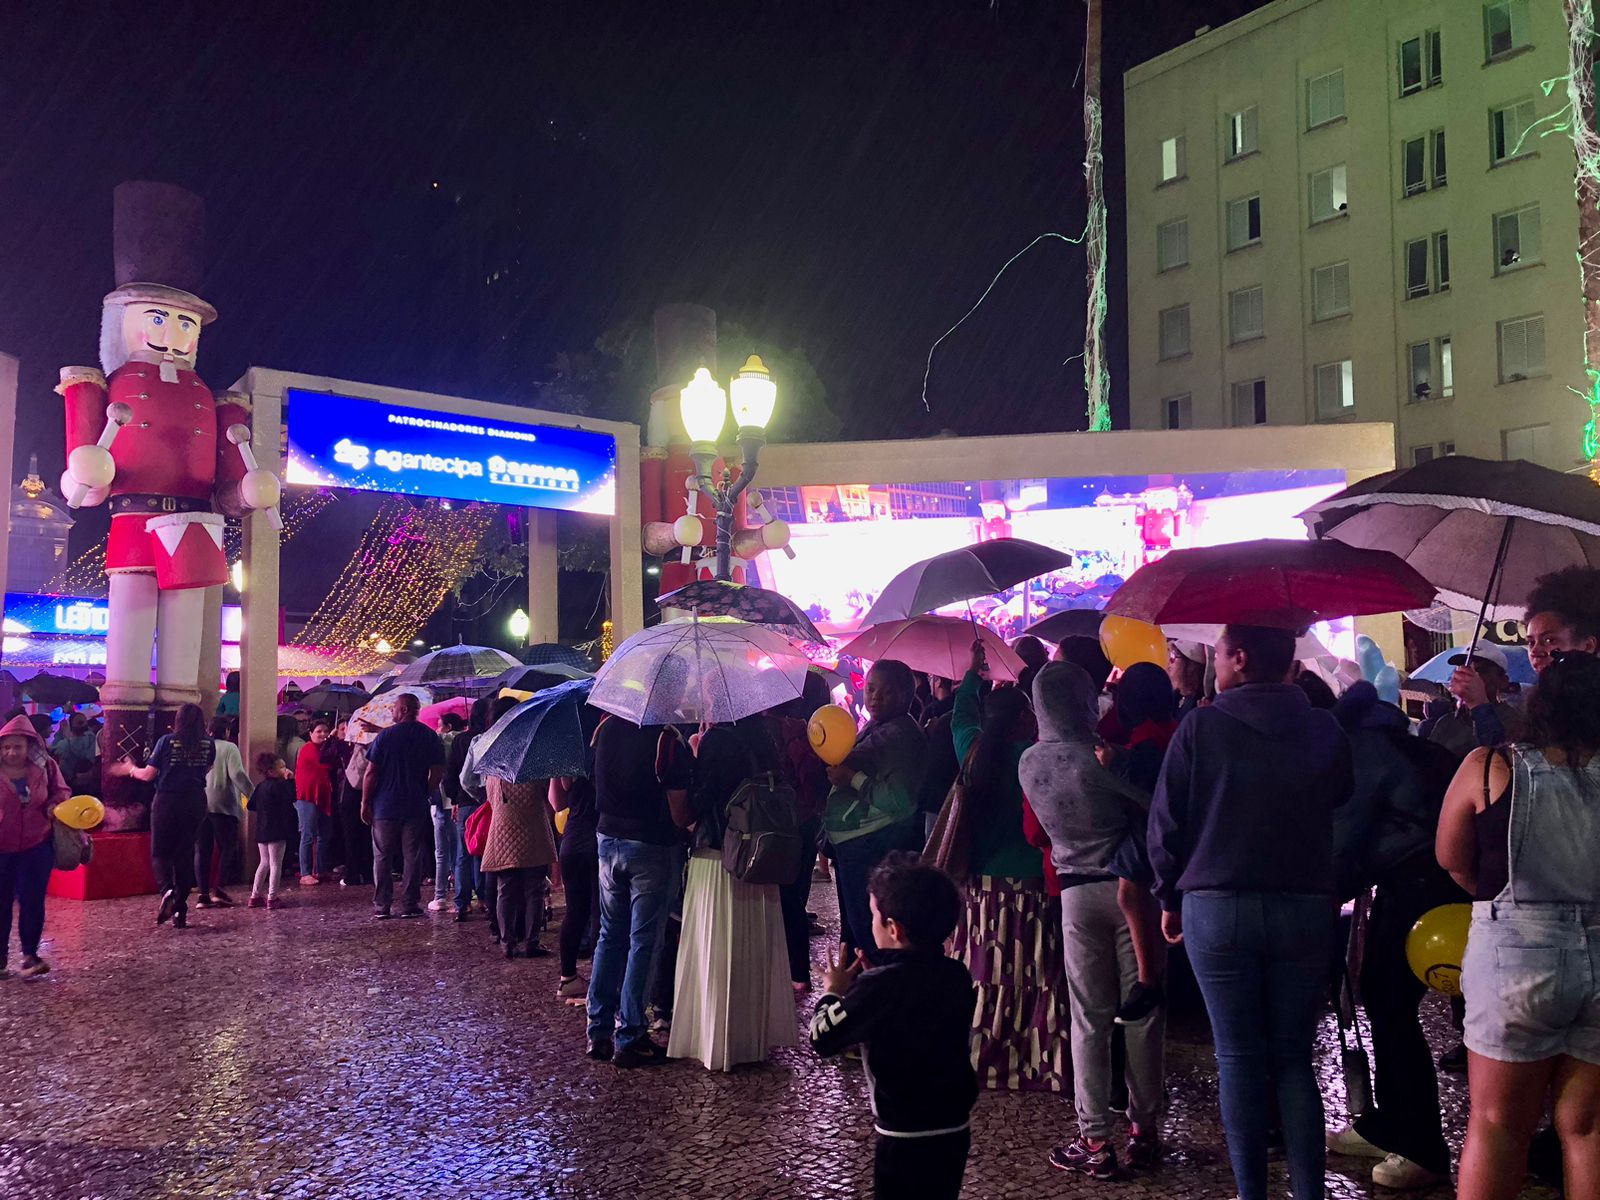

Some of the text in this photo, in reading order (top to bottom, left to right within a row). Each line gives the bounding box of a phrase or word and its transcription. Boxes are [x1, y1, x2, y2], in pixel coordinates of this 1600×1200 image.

[388, 413, 536, 442] PATROCINADORES DIAMOND
[375, 448, 483, 478] agantecipa
